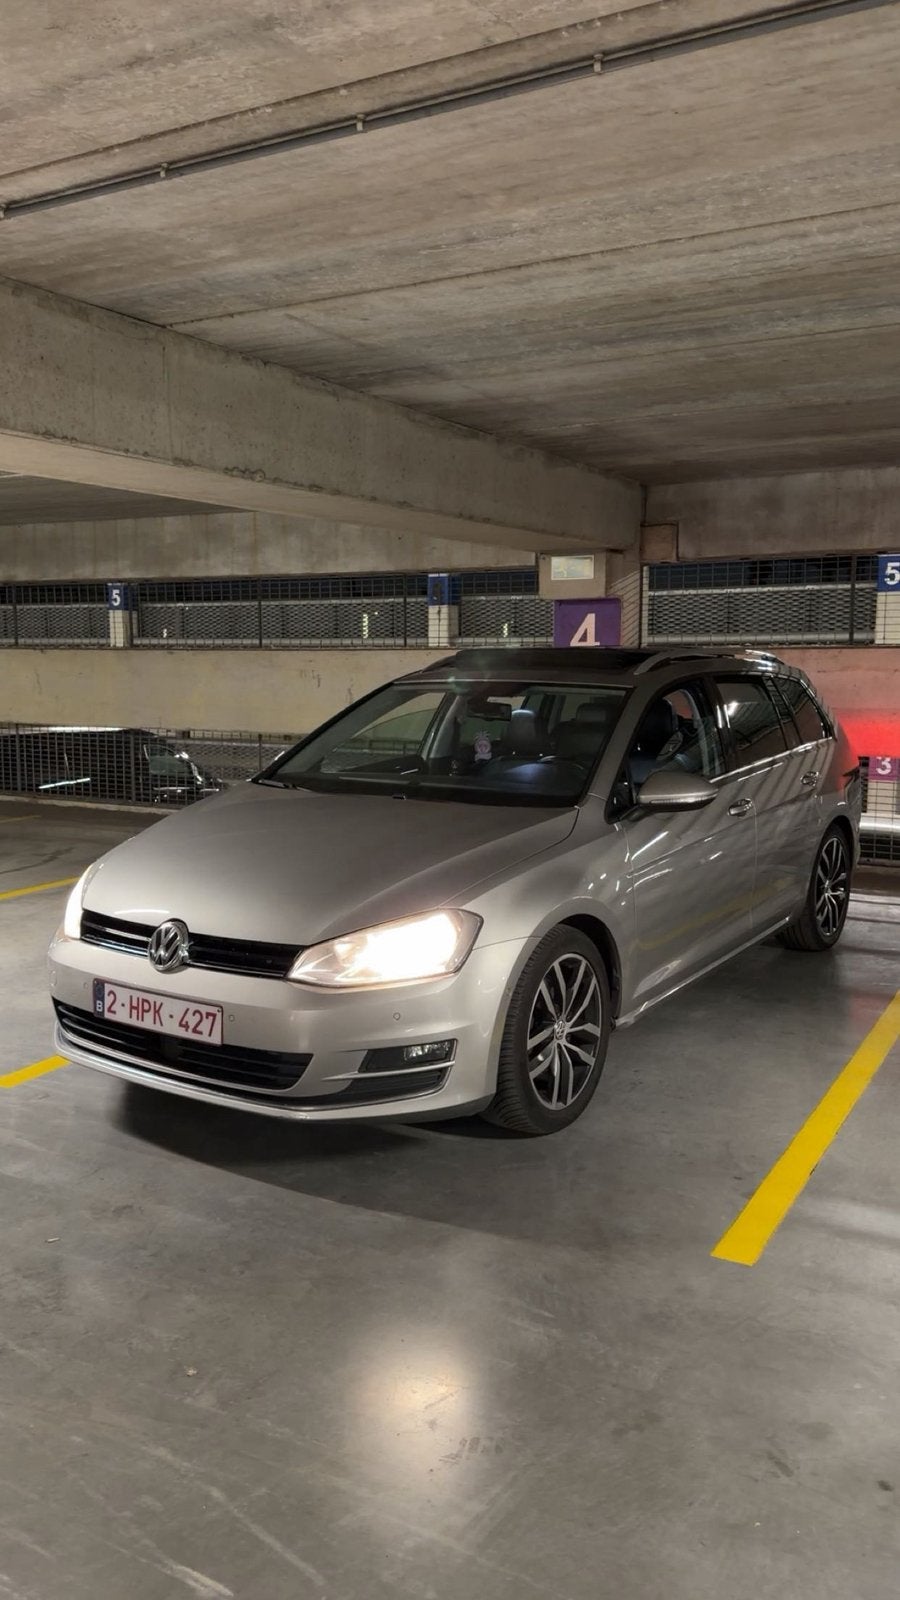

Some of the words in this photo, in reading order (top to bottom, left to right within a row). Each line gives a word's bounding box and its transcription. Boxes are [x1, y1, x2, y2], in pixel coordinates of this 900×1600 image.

[884, 562, 900, 585] 5
[112, 589, 121, 606] 5
[569, 613, 600, 647] 4
[876, 756, 892, 775] 3
[96, 1000, 103, 1012] B
